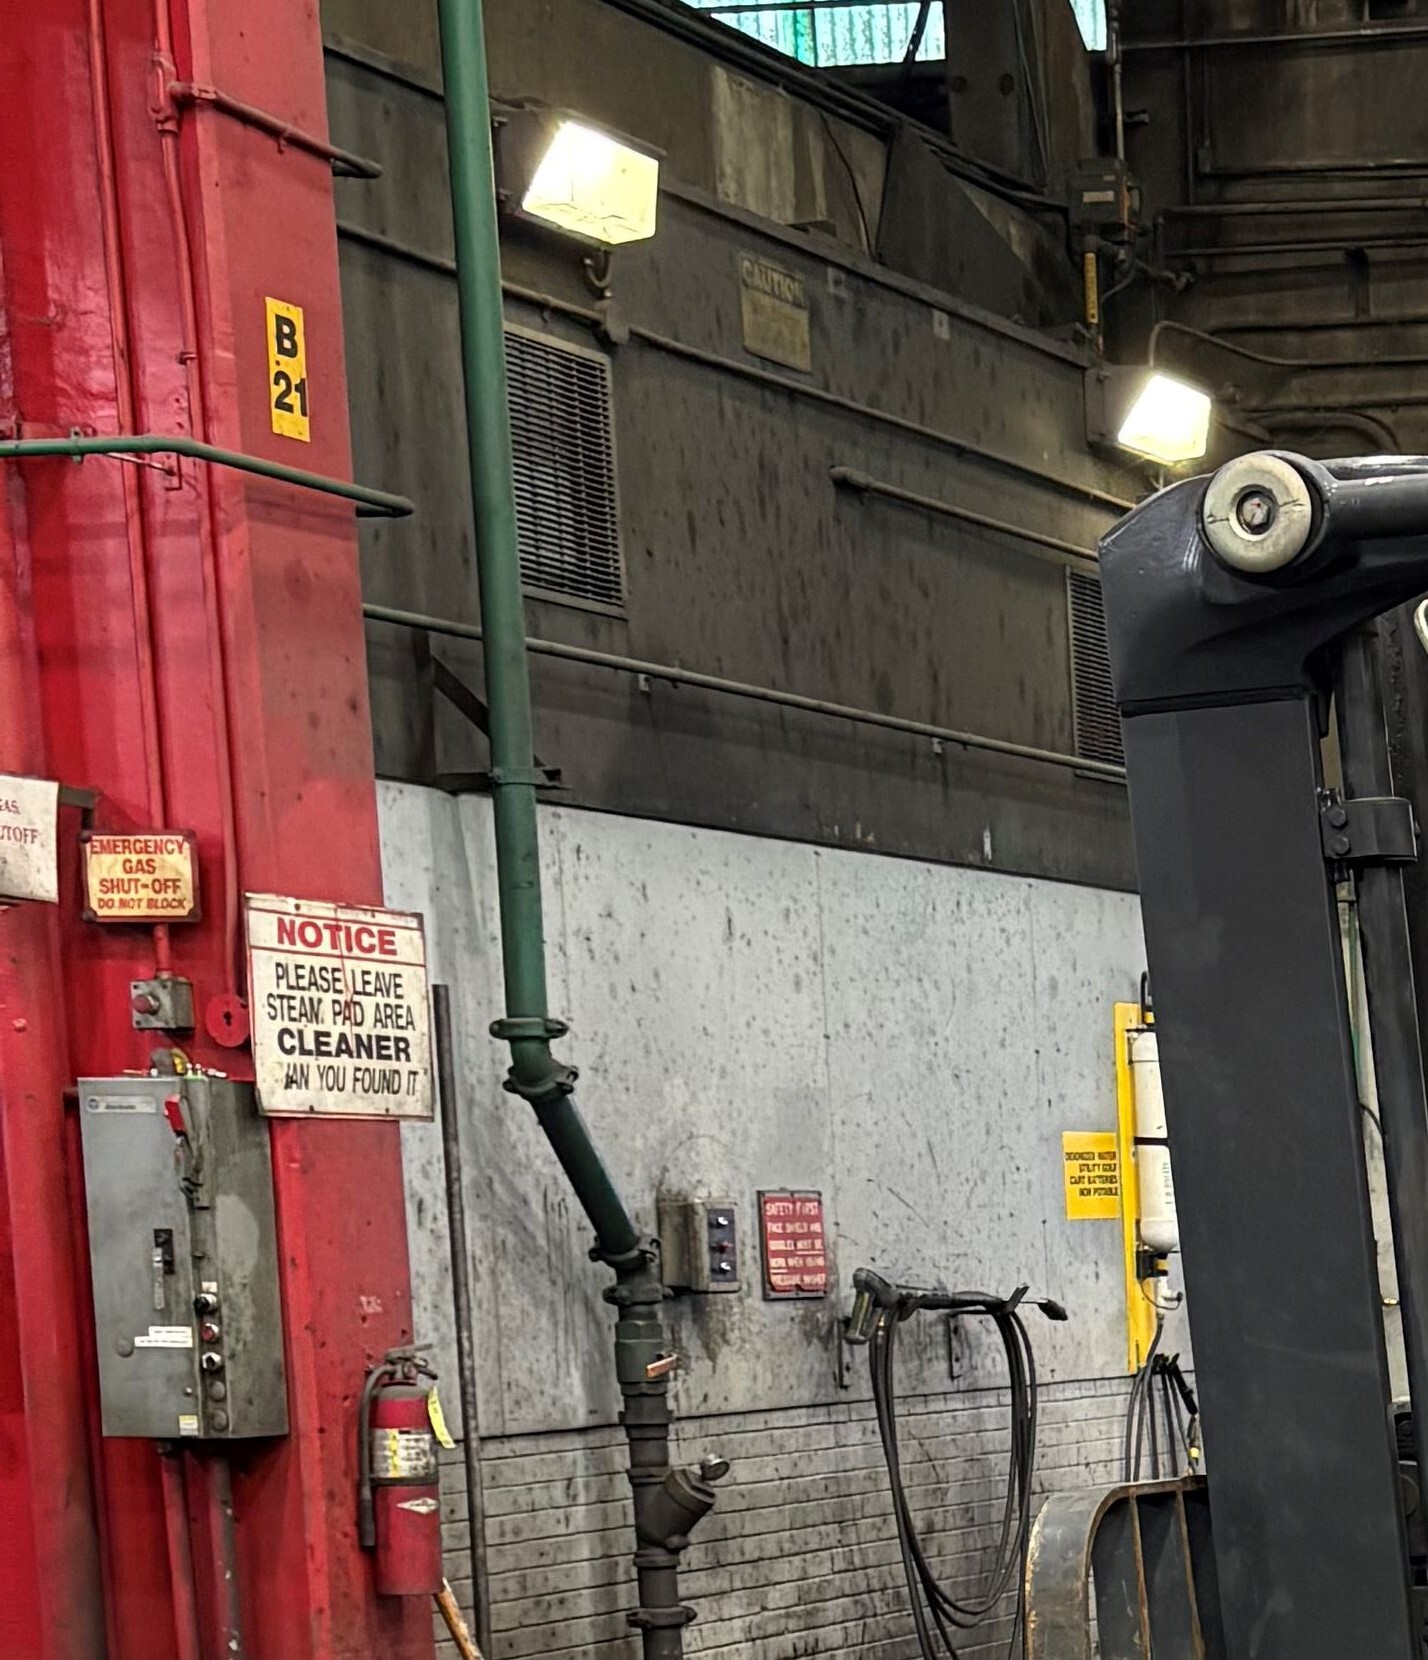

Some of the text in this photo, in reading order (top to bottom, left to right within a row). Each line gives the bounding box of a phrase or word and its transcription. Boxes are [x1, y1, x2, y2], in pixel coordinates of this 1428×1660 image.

[275, 313, 298, 358] B
[273, 370, 308, 417] 21
[90, 838, 186, 855] EMERGENCY
[122, 858, 157, 875] GAS
[99, 878, 182, 895] SHUT-OFF
[97, 898, 187, 910] DO NOT BLOCK
[277, 917, 397, 956] NOTICE
[275, 962, 404, 999] PLEASE LEAVE
[332, 999, 365, 1027] PAD
[373, 1002, 416, 1031] AREA
[277, 1028, 411, 1062] CLEANER
[317, 1064, 346, 1092] YOU
[353, 1067, 401, 1095] FOUND
[406, 1071, 418, 1096] IT
[766, 1202, 793, 1215] SAFETY
